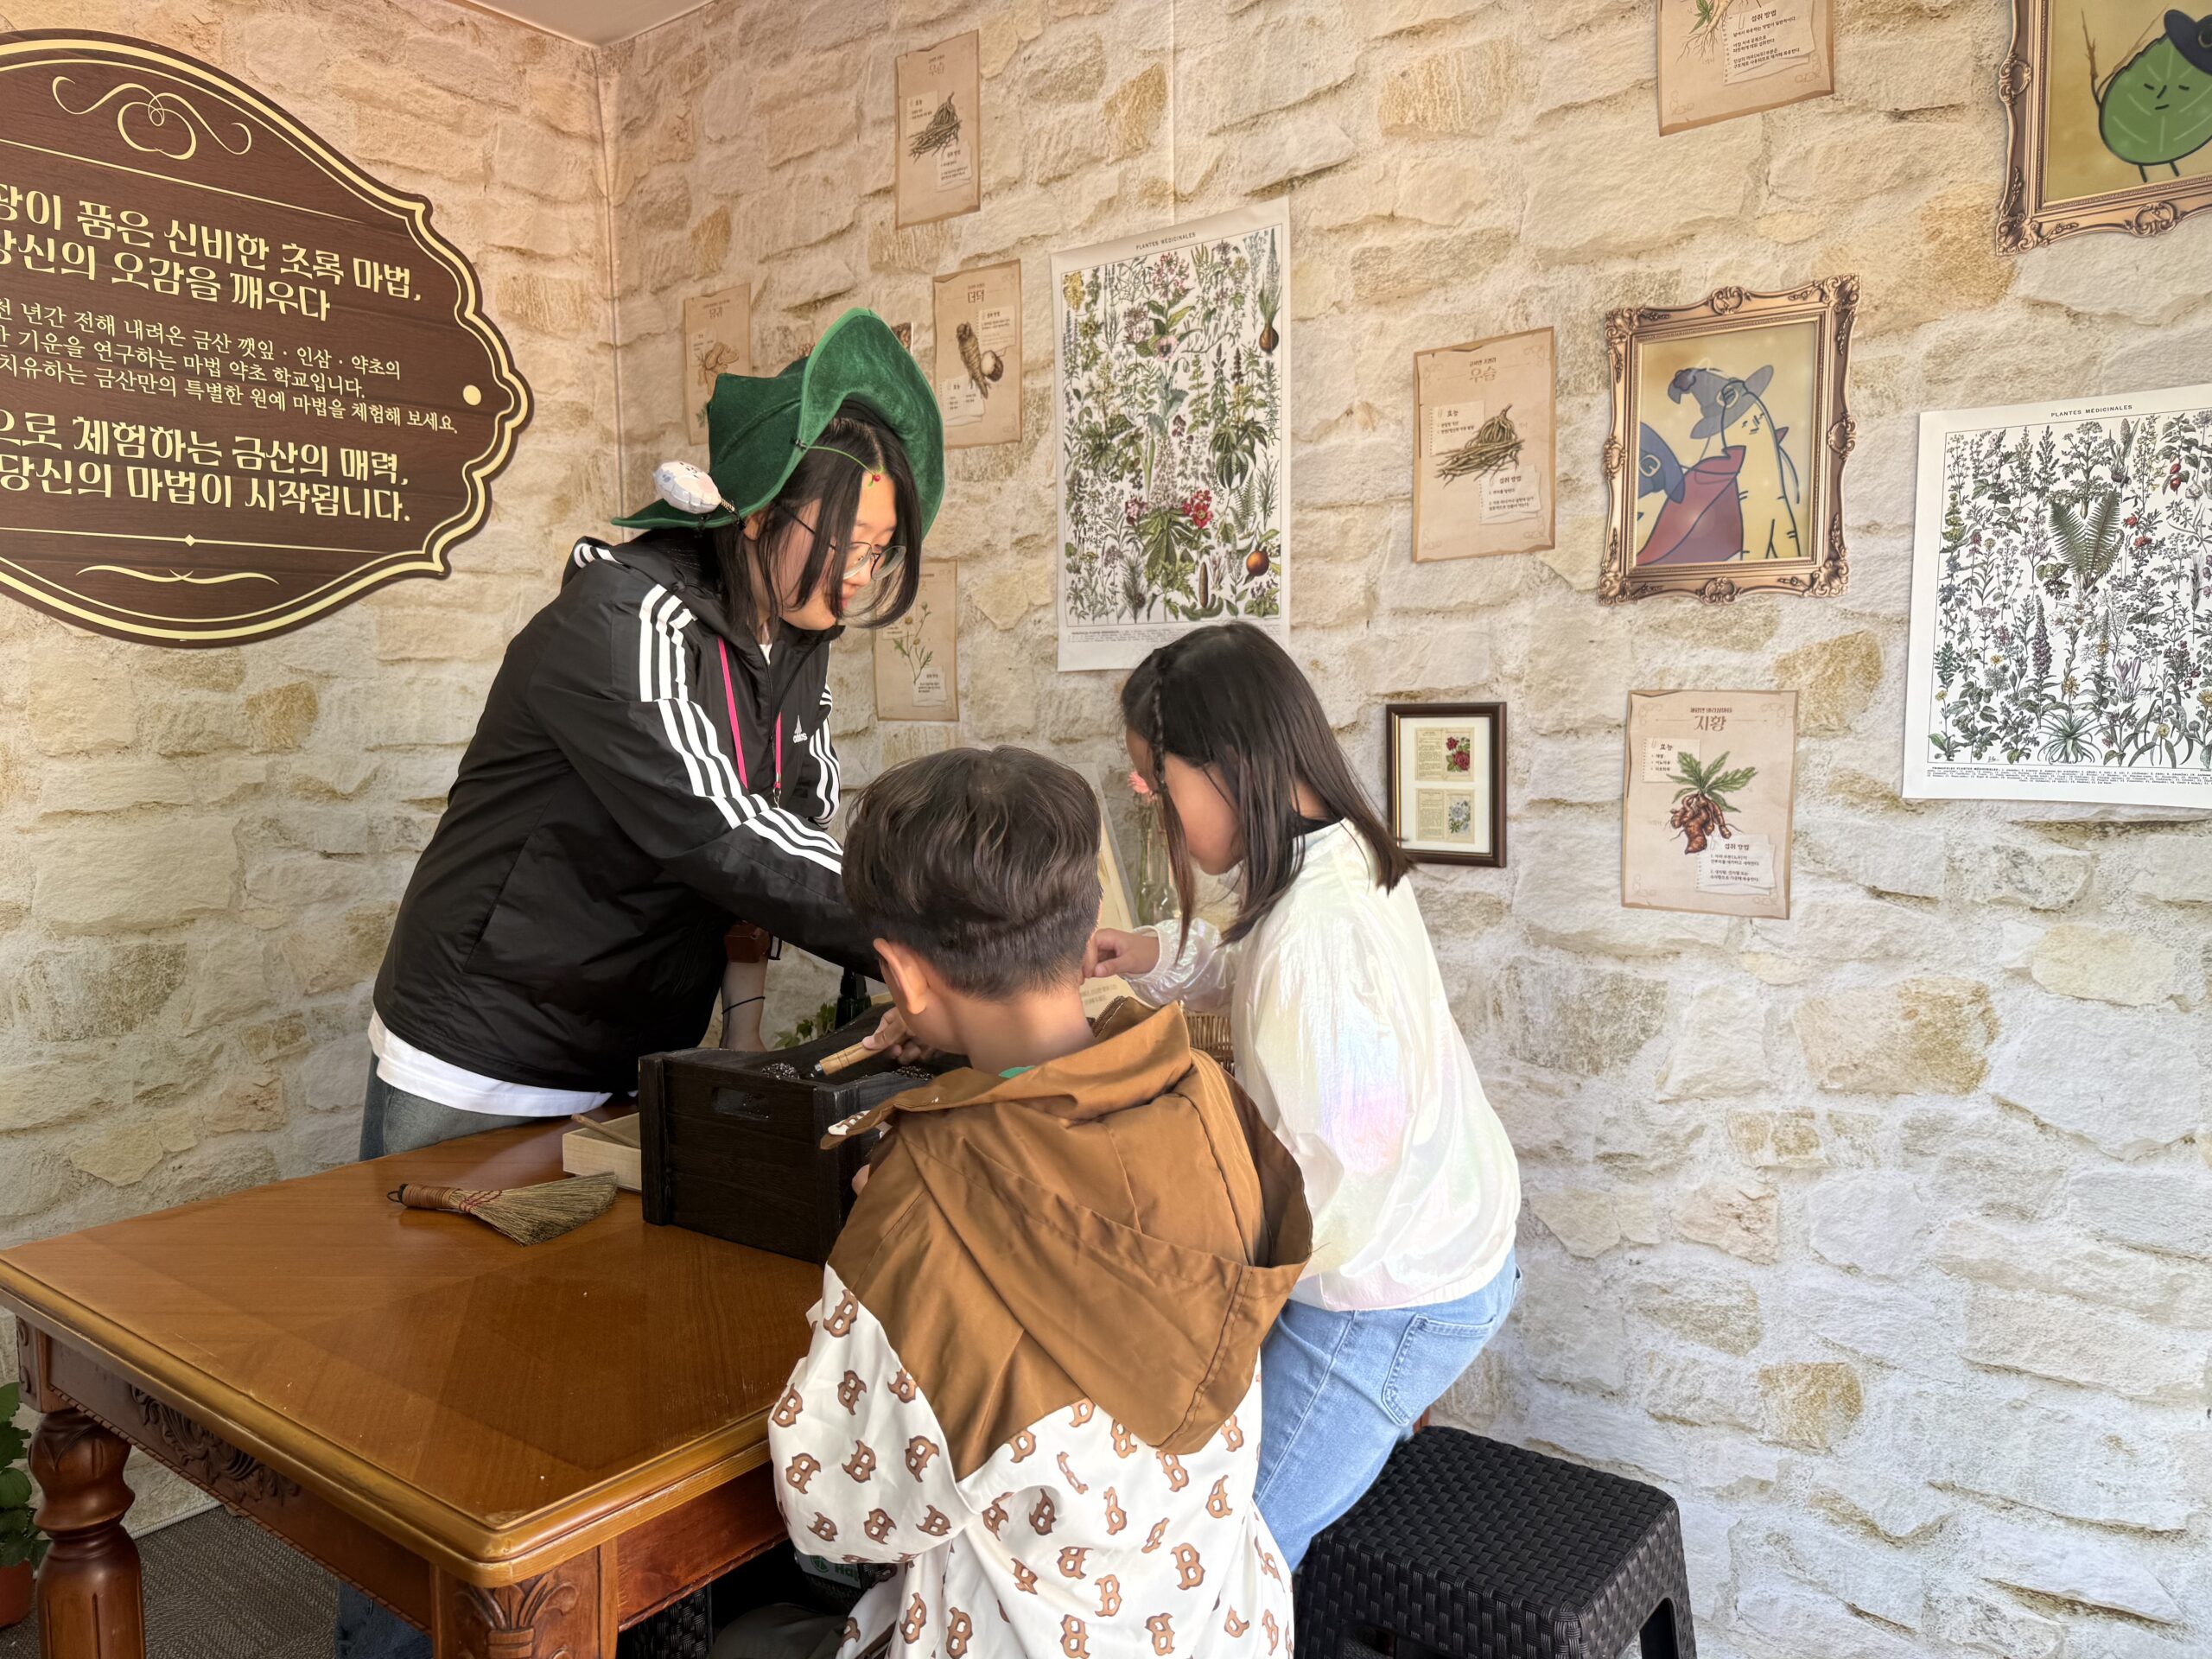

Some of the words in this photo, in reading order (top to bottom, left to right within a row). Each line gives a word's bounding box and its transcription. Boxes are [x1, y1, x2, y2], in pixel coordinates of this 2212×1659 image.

[77, 200, 155, 249] 품은
[163, 219, 270, 271] 신비한
[280, 243, 344, 285] 초록
[353, 257, 422, 301] 마법,
[1135, 240, 1159, 251] PLANTES
[111, 251, 221, 302] 오감을
[229, 272, 331, 322] 깨우다
[18, 329, 86, 359] 기운을
[93, 340, 177, 372] 연구하는
[183, 353, 221, 378] 마법
[229, 360, 268, 383] 약초
[272, 366, 365, 398] 학교입니다.
[20, 302, 67, 328] 년간
[73, 311, 116, 337] 전해
[124, 319, 187, 346] 내려온
[192, 329, 232, 354] 금산
[238, 337, 275, 360] 깻잎
[296, 346, 332, 370] 인삼
[351, 355, 400, 381] 약초의
[1469, 366, 1497, 383] 우슬
[0, 353, 87, 385] 치유하는
[94, 367, 177, 397] 금산만의
[184, 378, 245, 406] 특별한
[250, 388, 286, 412] 원예
[293, 394, 346, 419] 마법을
[351, 402, 401, 427] 체험해
[2085, 404, 2133, 414] MÉDICINALES
[73, 416, 222, 467] 체험하는
[232, 435, 328, 478] 금산의
[340, 448, 409, 486] 매력,
[0, 454, 111, 499] 당신의
[127, 466, 232, 508] 마법이
[245, 478, 410, 522] 시작됩니다.
[1694, 715, 1726, 732] 지황
